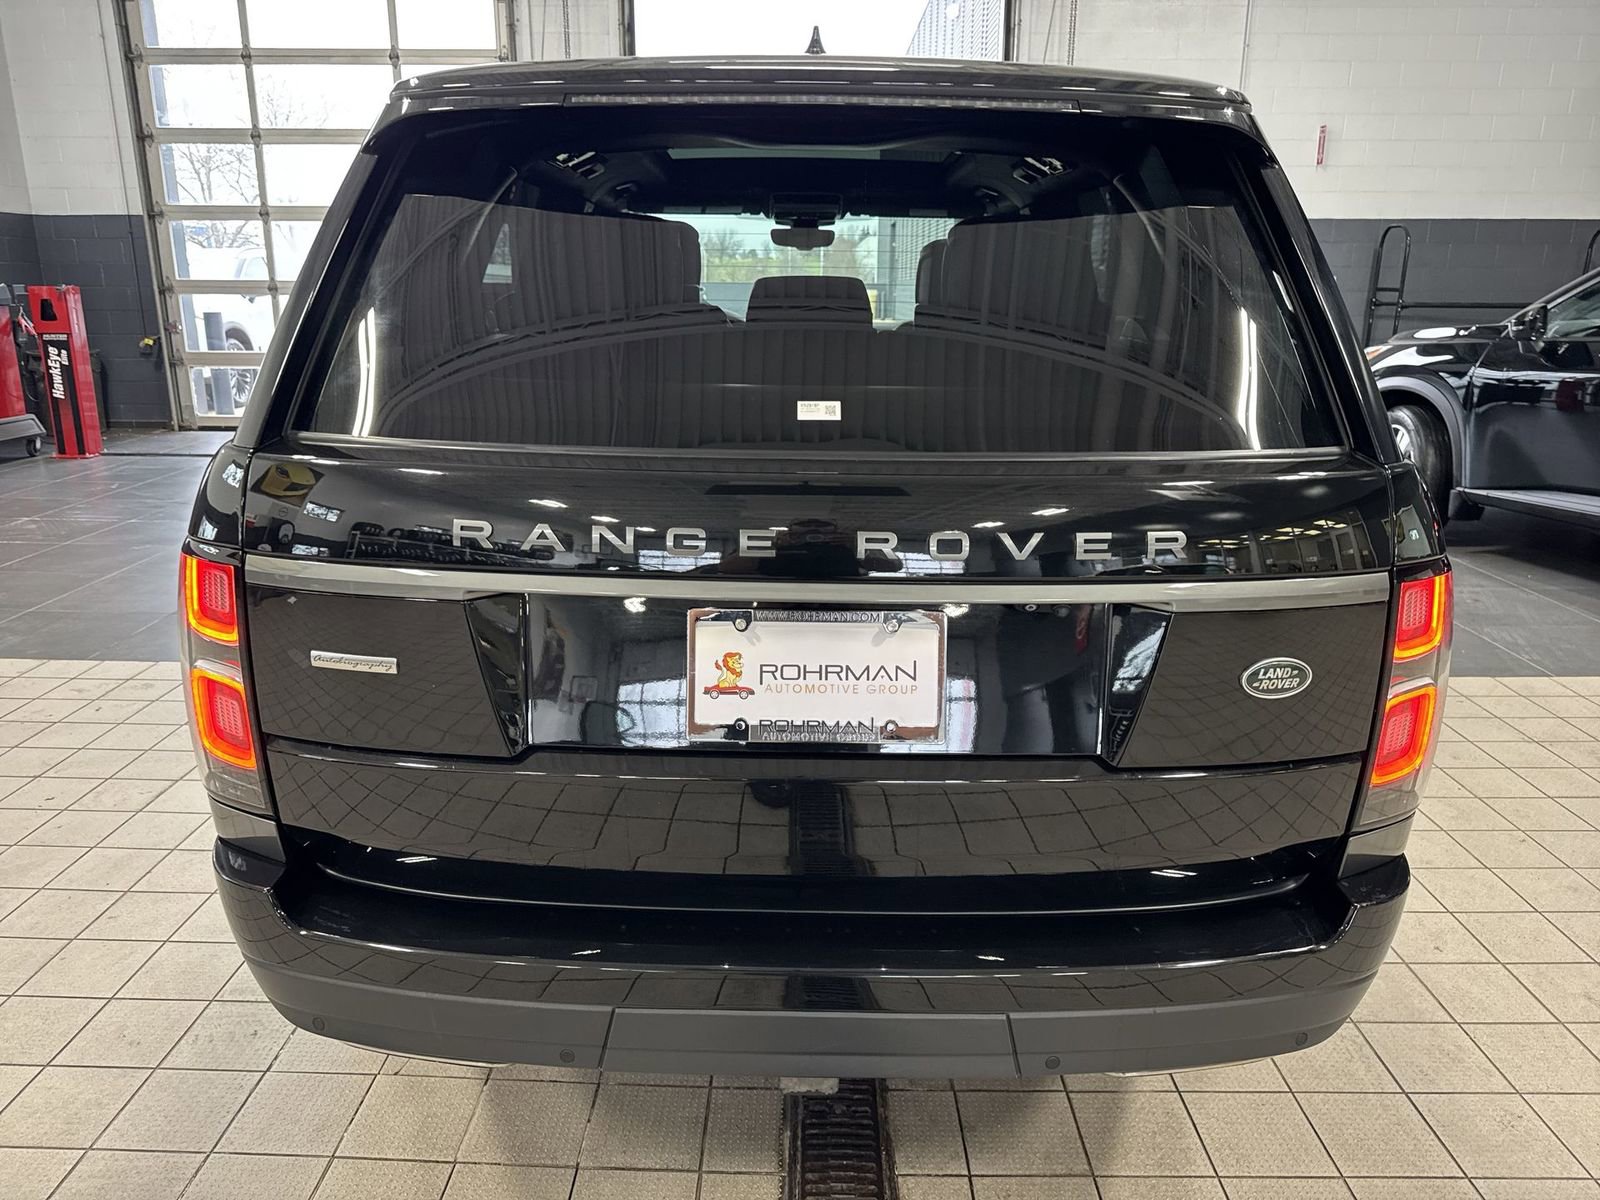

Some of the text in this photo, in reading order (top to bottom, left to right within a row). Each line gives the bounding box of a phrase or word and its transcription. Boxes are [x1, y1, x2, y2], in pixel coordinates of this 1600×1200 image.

[48, 345, 65, 399] HawkEye
[452, 518, 1188, 561] RANGE ROVER
[759, 660, 917, 685] ROHRMAN
[1258, 667, 1292, 679] LAND
[764, 683, 918, 695] AUTOMOTIVE GROUP
[1259, 678, 1300, 690] ROVER
[758, 717, 874, 735] ROHRMAN
